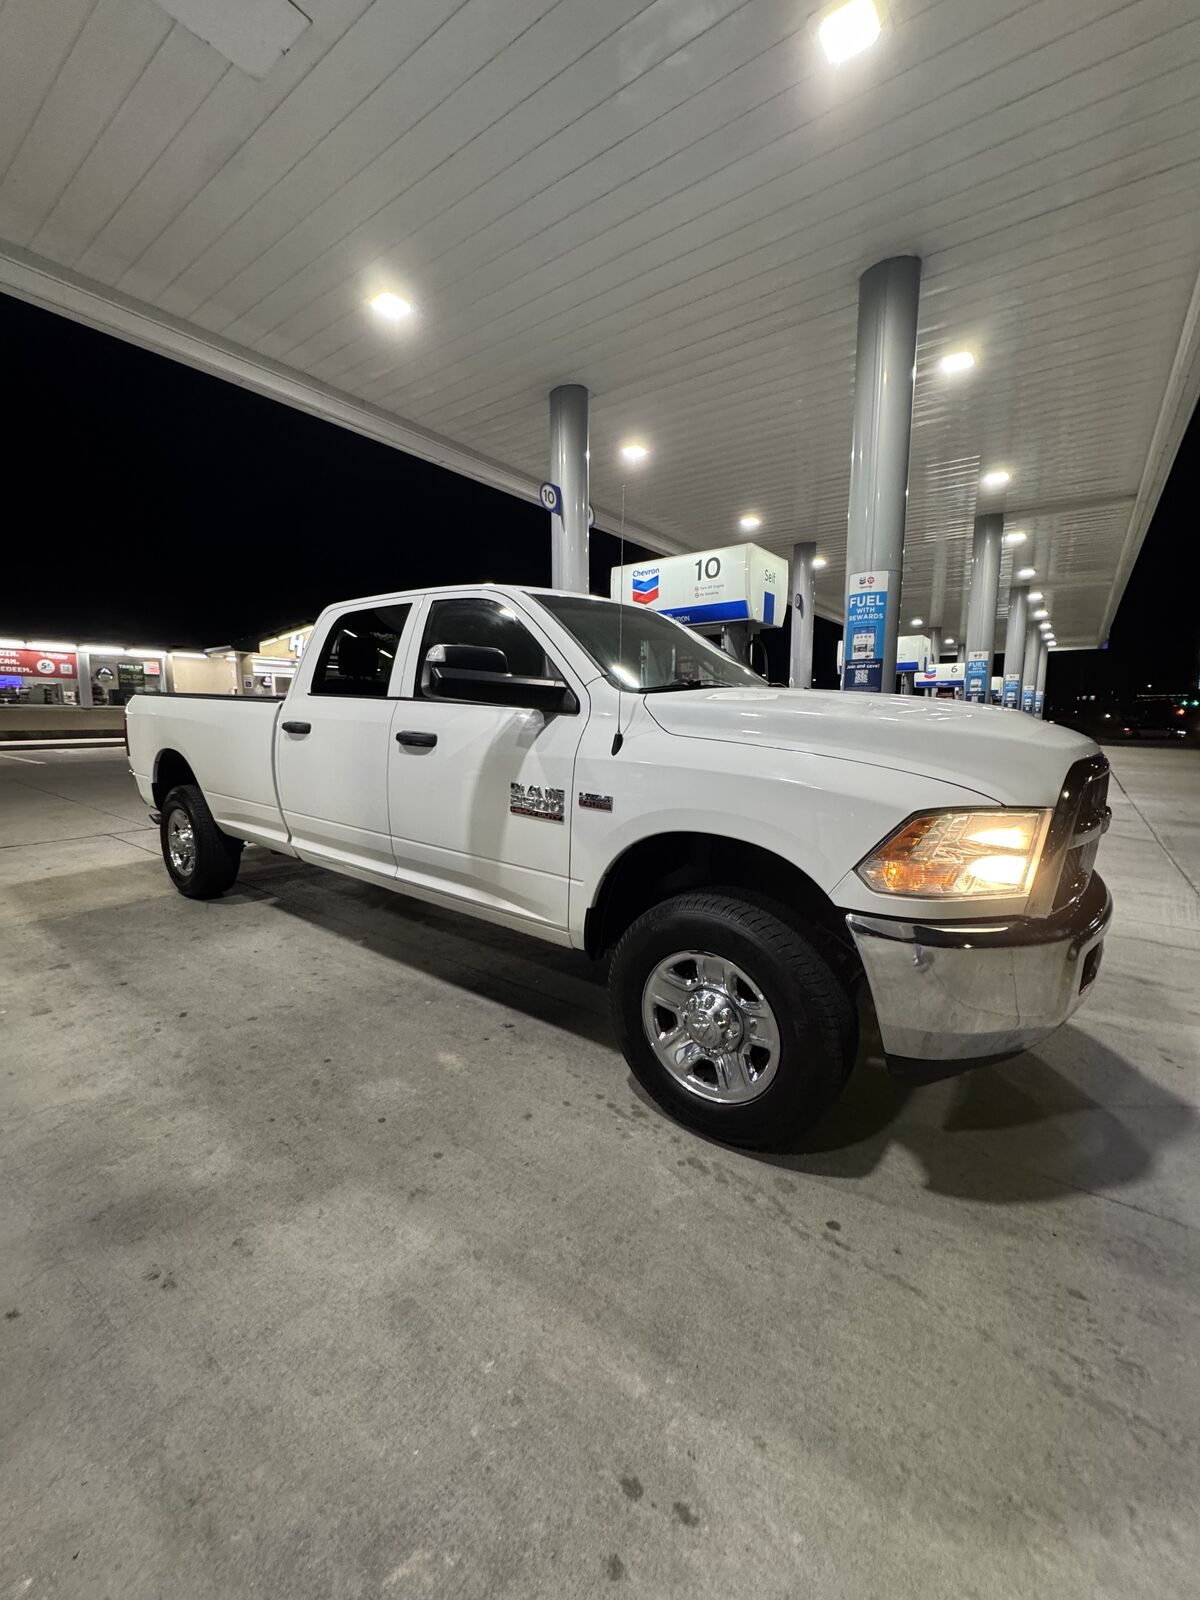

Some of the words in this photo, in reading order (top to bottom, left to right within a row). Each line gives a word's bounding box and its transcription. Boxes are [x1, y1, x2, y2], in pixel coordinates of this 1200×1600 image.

[543, 489, 555, 504] 10
[632, 567, 660, 578] Chevron
[695, 557, 721, 581] 10
[764, 569, 776, 584] Self
[850, 595, 884, 608] FUEL
[849, 613, 883, 621] REWARDS
[951, 665, 958, 674] 6
